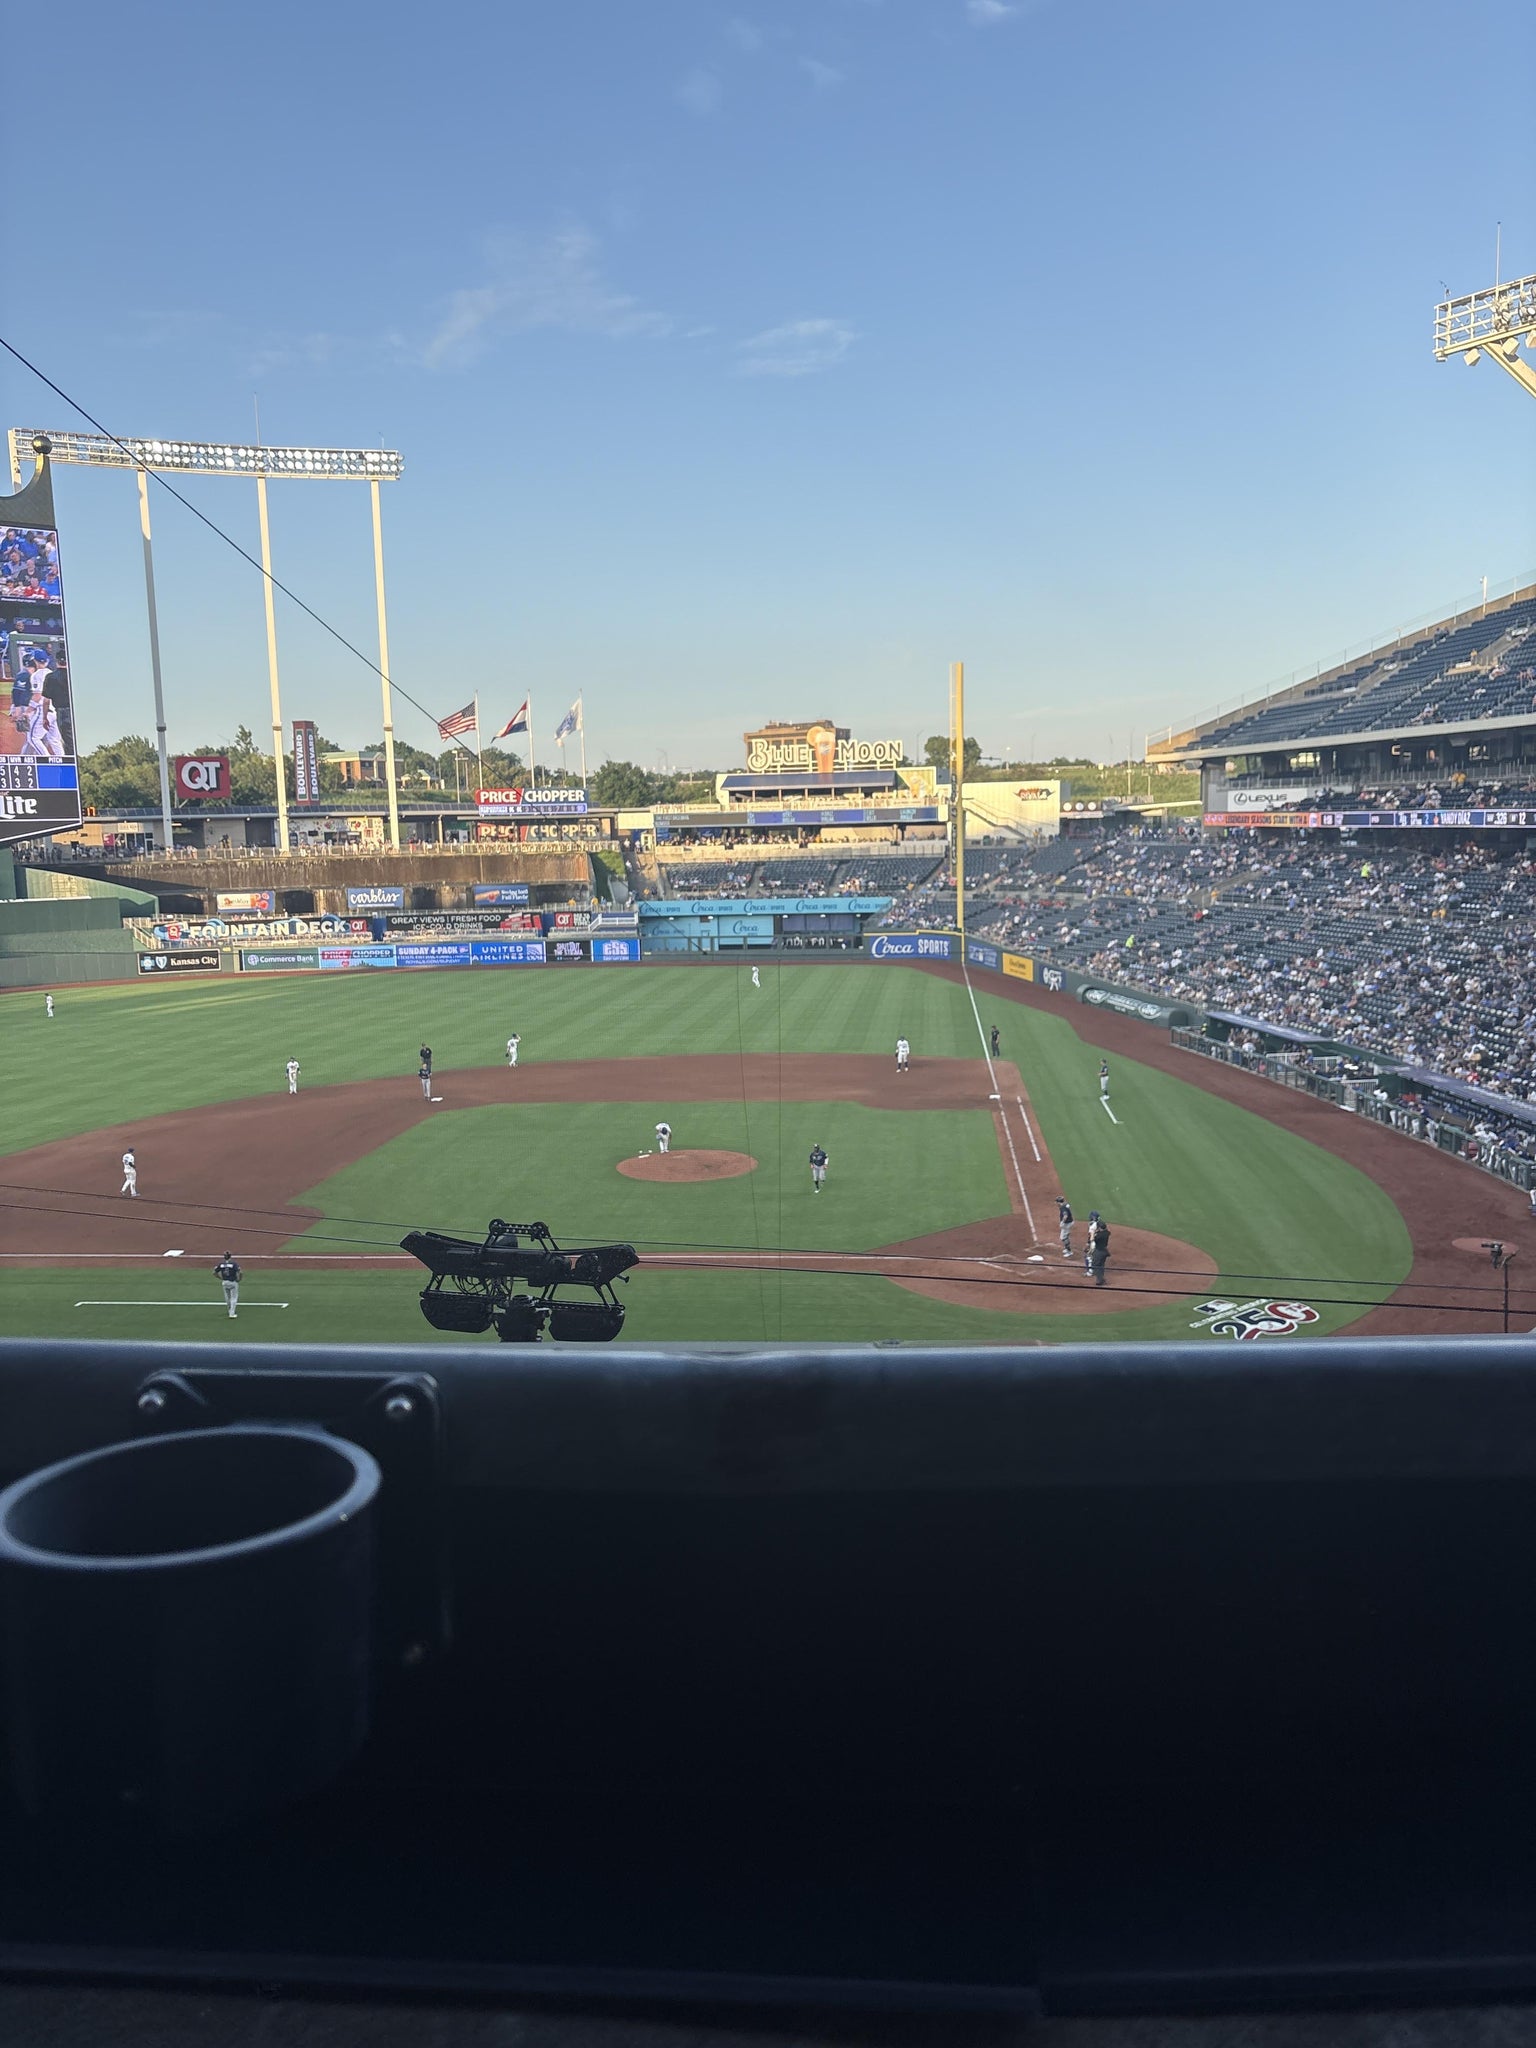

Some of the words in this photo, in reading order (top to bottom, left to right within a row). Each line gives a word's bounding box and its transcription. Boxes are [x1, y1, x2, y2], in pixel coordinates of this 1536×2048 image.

[748, 738, 809, 772] BLUE
[837, 738, 903, 763] MOON
[296, 734, 306, 795] BOULEVARD
[308, 734, 318, 795] BOULEVARD
[14, 766, 19, 776] 4
[27, 766, 32, 776] 2
[181, 761, 220, 792] QT
[1, 778, 6, 788] 3
[15, 778, 20, 788] 3
[28, 778, 33, 788] 2
[480, 791, 518, 802] PRICE
[524, 790, 584, 802] CHOPPER
[1248, 794, 1287, 802] LEXUS
[350, 888, 400, 904] carbliss
[392, 916, 418, 924] GREAT
[557, 915, 570, 924] QT
[190, 920, 290, 938] FOUNTAIN
[295, 920, 346, 935] DECK
[352, 922, 364, 930] QT
[733, 920, 759, 934] Circa
[398, 947, 429, 955] SUNDAY
[431, 946, 458, 955] 4-PACK
[872, 936, 914, 958] Circa
[918, 938, 949, 956] SPORTS
[297, 955, 314, 963] Bank
[353, 950, 390, 958] CHOPPER
[472, 952, 523, 961] AIRLINES
[171, 957, 199, 966] Kansas
[201, 956, 217, 965] City
